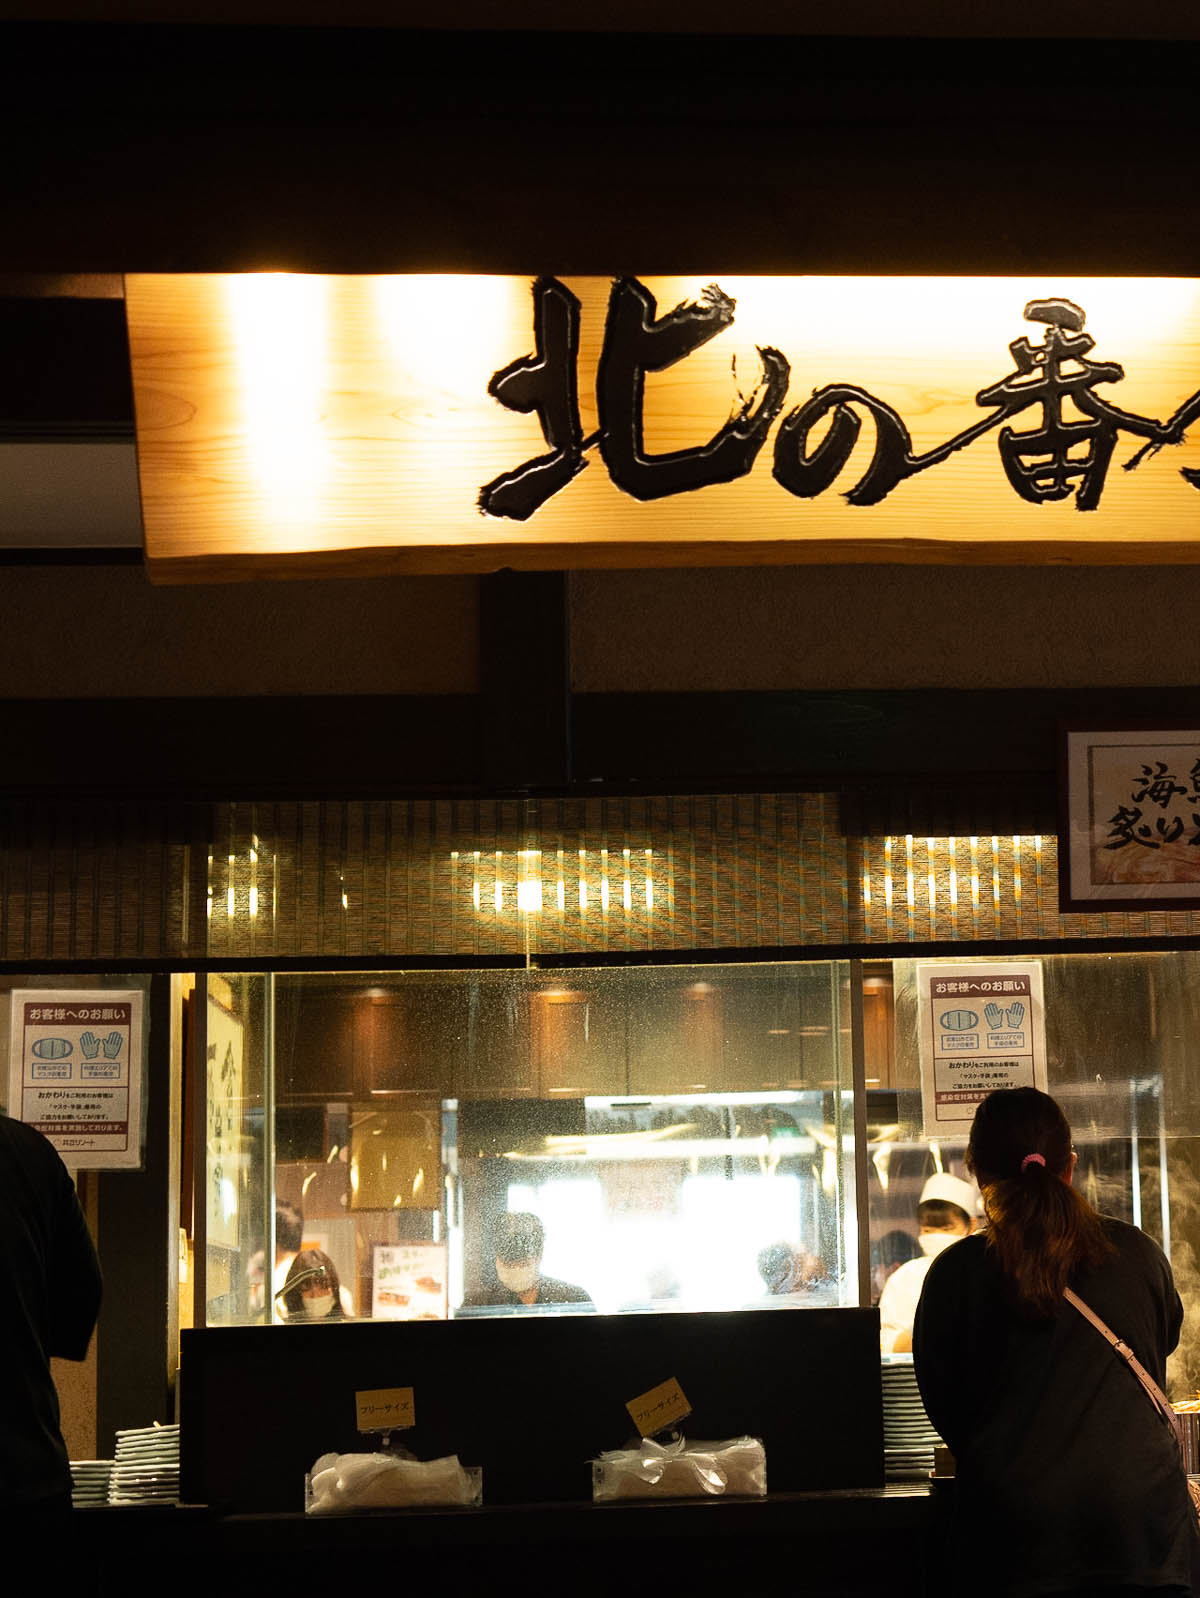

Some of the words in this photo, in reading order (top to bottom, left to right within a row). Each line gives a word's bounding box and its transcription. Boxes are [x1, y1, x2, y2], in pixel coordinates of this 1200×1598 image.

[936, 980, 1026, 993] お客様へのお願い
[30, 1008, 126, 1020] お客様へのお願い
[360, 1402, 410, 1415] フリーサイズ
[637, 1392, 681, 1422] フリーサイズ
